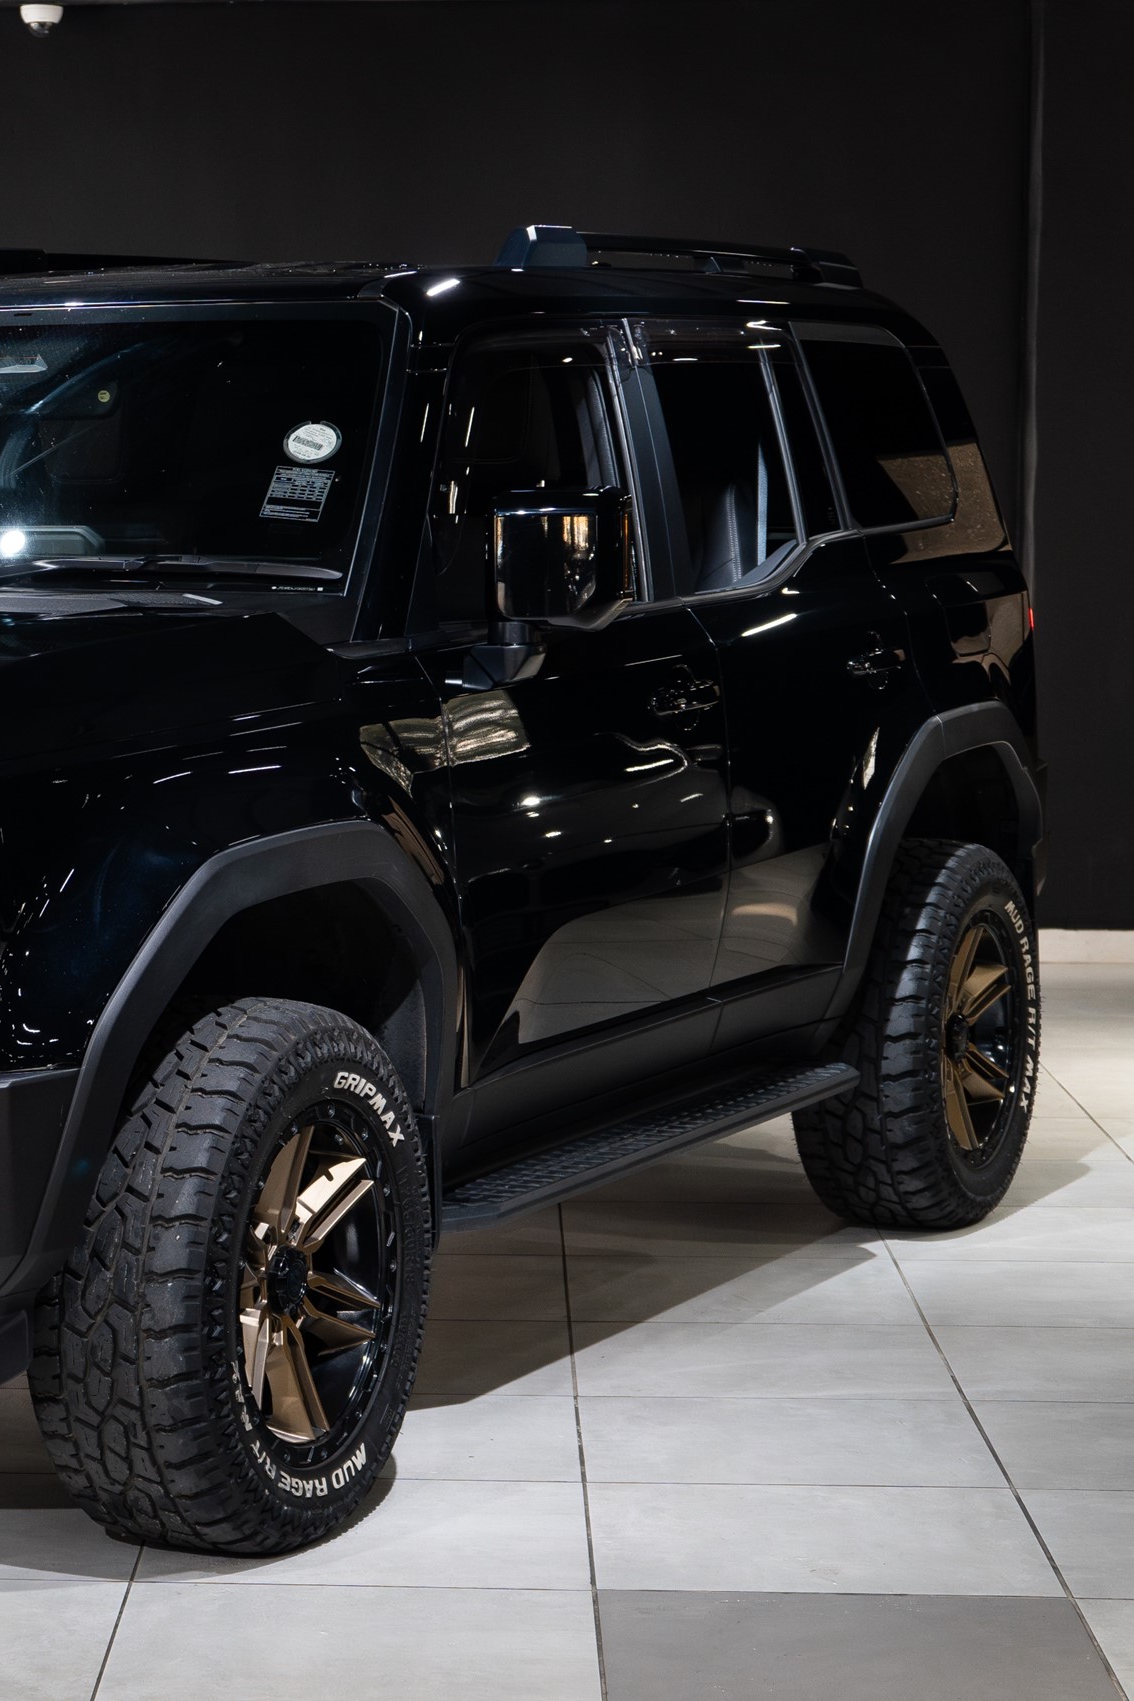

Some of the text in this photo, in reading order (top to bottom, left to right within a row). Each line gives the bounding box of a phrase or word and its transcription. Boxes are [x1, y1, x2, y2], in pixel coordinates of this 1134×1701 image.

[1004, 900, 1025, 934] MUD
[1019, 936, 1037, 1001] RAGE
[333, 1071, 406, 1149] GRIPMAX
[1020, 1054, 1034, 1114] MAX
[277, 1470, 329, 1498] RAGE
[331, 1442, 367, 1490] MUD
